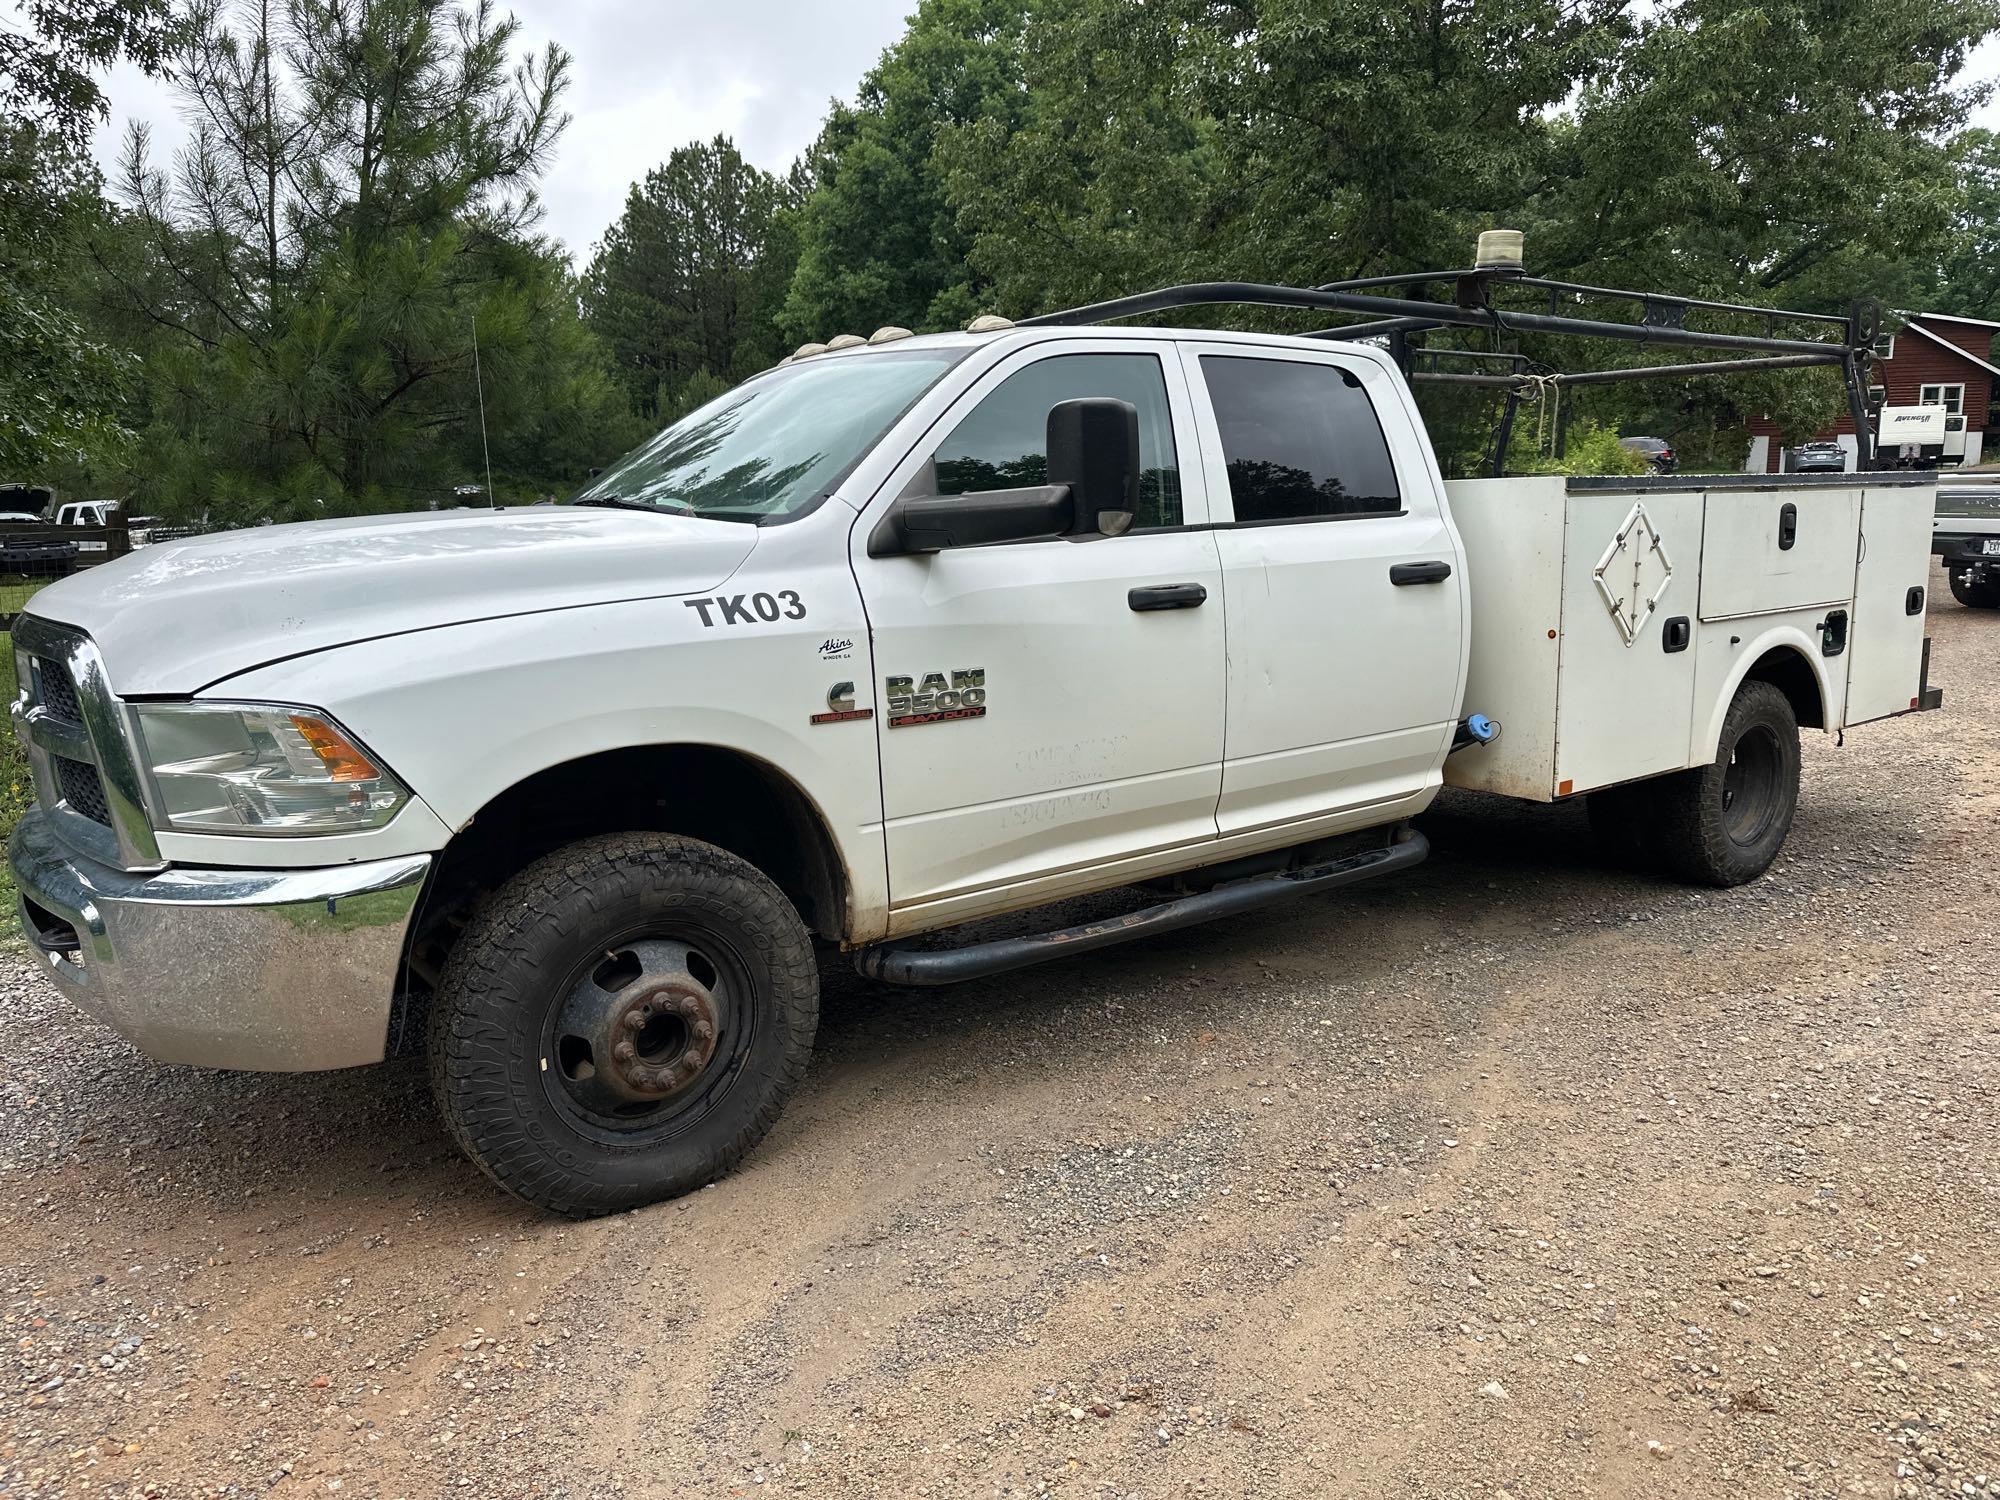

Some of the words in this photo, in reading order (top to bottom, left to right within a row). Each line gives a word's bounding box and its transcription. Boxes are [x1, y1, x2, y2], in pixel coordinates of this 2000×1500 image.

[1894, 415, 1931, 423] AVENGER
[683, 590, 807, 627] TK03
[818, 639, 854, 654] Akins
[886, 667, 985, 696] RAM
[887, 687, 986, 717] 3500
[813, 713, 842, 723] TURBO
[892, 714, 941, 726] HEAVY
[944, 707, 983, 719] DUTY
[526, 1119, 596, 1177] TOYO
